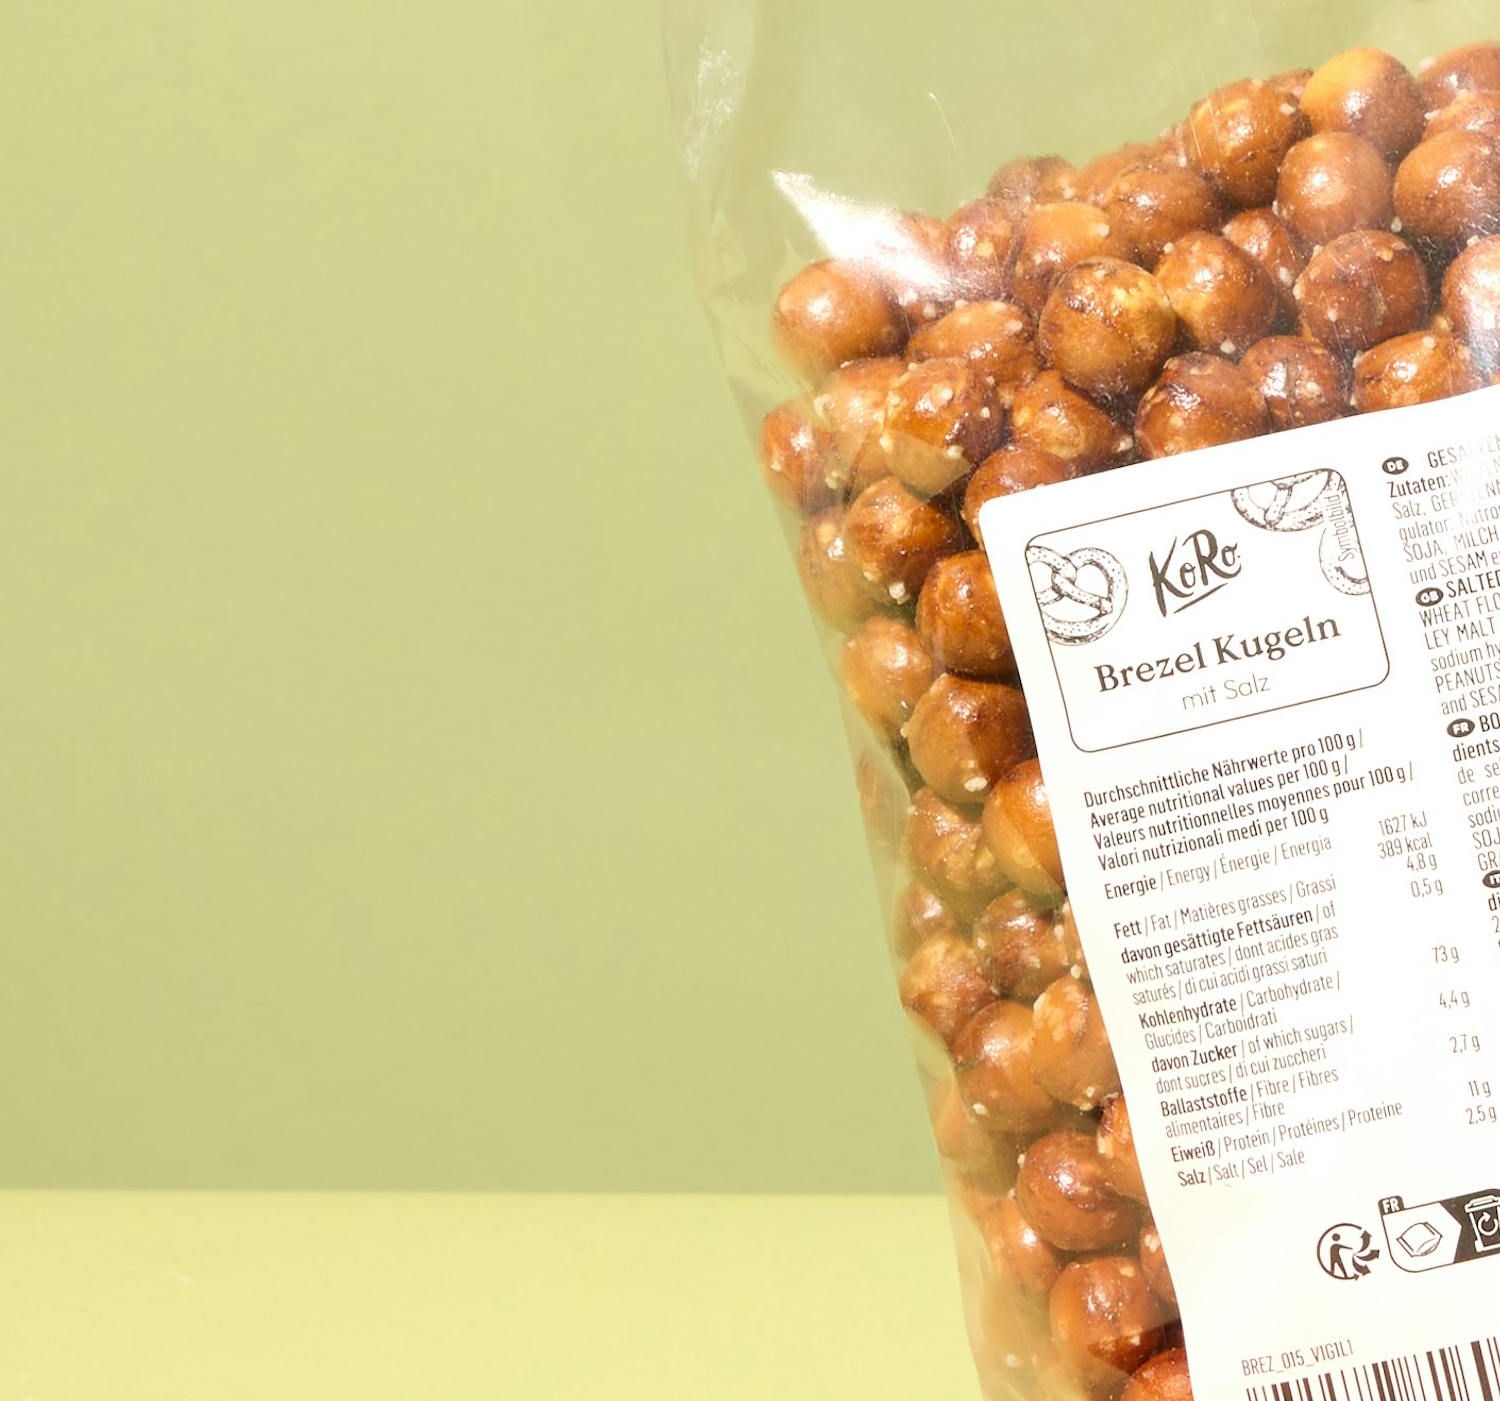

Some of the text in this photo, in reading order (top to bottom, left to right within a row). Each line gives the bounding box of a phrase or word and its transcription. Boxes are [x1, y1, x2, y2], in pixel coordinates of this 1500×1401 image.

[1386, 475, 1448, 499] Zutaten:
[1323, 492, 1355, 563] Symbolbild
[1148, 528, 1242, 618] KoRo
[1093, 615, 1342, 693] Brezel Kugeln
[1181, 673, 1271, 711] mit Salz
[1083, 767, 1210, 808] Durchschnittliche
[1211, 749, 1289, 779] Nährwerte
[1291, 743, 1317, 764] pro
[1317, 733, 1344, 754] 100
[1090, 805, 1146, 829] Average
[1147, 783, 1226, 817] nutritional
[1226, 775, 1275, 798] values
[1276, 769, 1300, 790] per
[1302, 759, 1329, 780] 100
[1092, 827, 1147, 850] Valeurs
[1148, 802, 1255, 839] nutritionnelles
[1257, 784, 1331, 814] moyennes
[1332, 776, 1365, 799] pour
[1368, 765, 1395, 787] 100
[1097, 847, 1140, 872] Valori
[1141, 827, 1224, 862] nutrizionali
[1226, 818, 1263, 843] medi
[1264, 816, 1288, 837] per
[1290, 806, 1317, 828] 100
[1378, 810, 1428, 837] 1627 kJ
[1377, 831, 1433, 860] 389 kcal
[1406, 852, 1427, 872] 4,8
[1410, 877, 1433, 898] 0,5
[1120, 899, 1336, 965] davon gesättigte Fettsäuren of
[1431, 944, 1449, 964] 73
[1439, 989, 1458, 1009] 4,4
[1138, 998, 1238, 1037] Kohlenhydrate
[1151, 1054, 1190, 1073] davon
[1190, 1044, 1237, 1066] Zucker
[1247, 1034, 1262, 1055] of
[1262, 1027, 1303, 1050] which
[1448, 1033, 1468, 1054] 2,7
[1160, 1086, 1248, 1118] Ballaststoffe
[1467, 1079, 1480, 1097] 11
[1465, 1104, 1487, 1126] 2,5
[1381, 1196, 1401, 1215] FR
